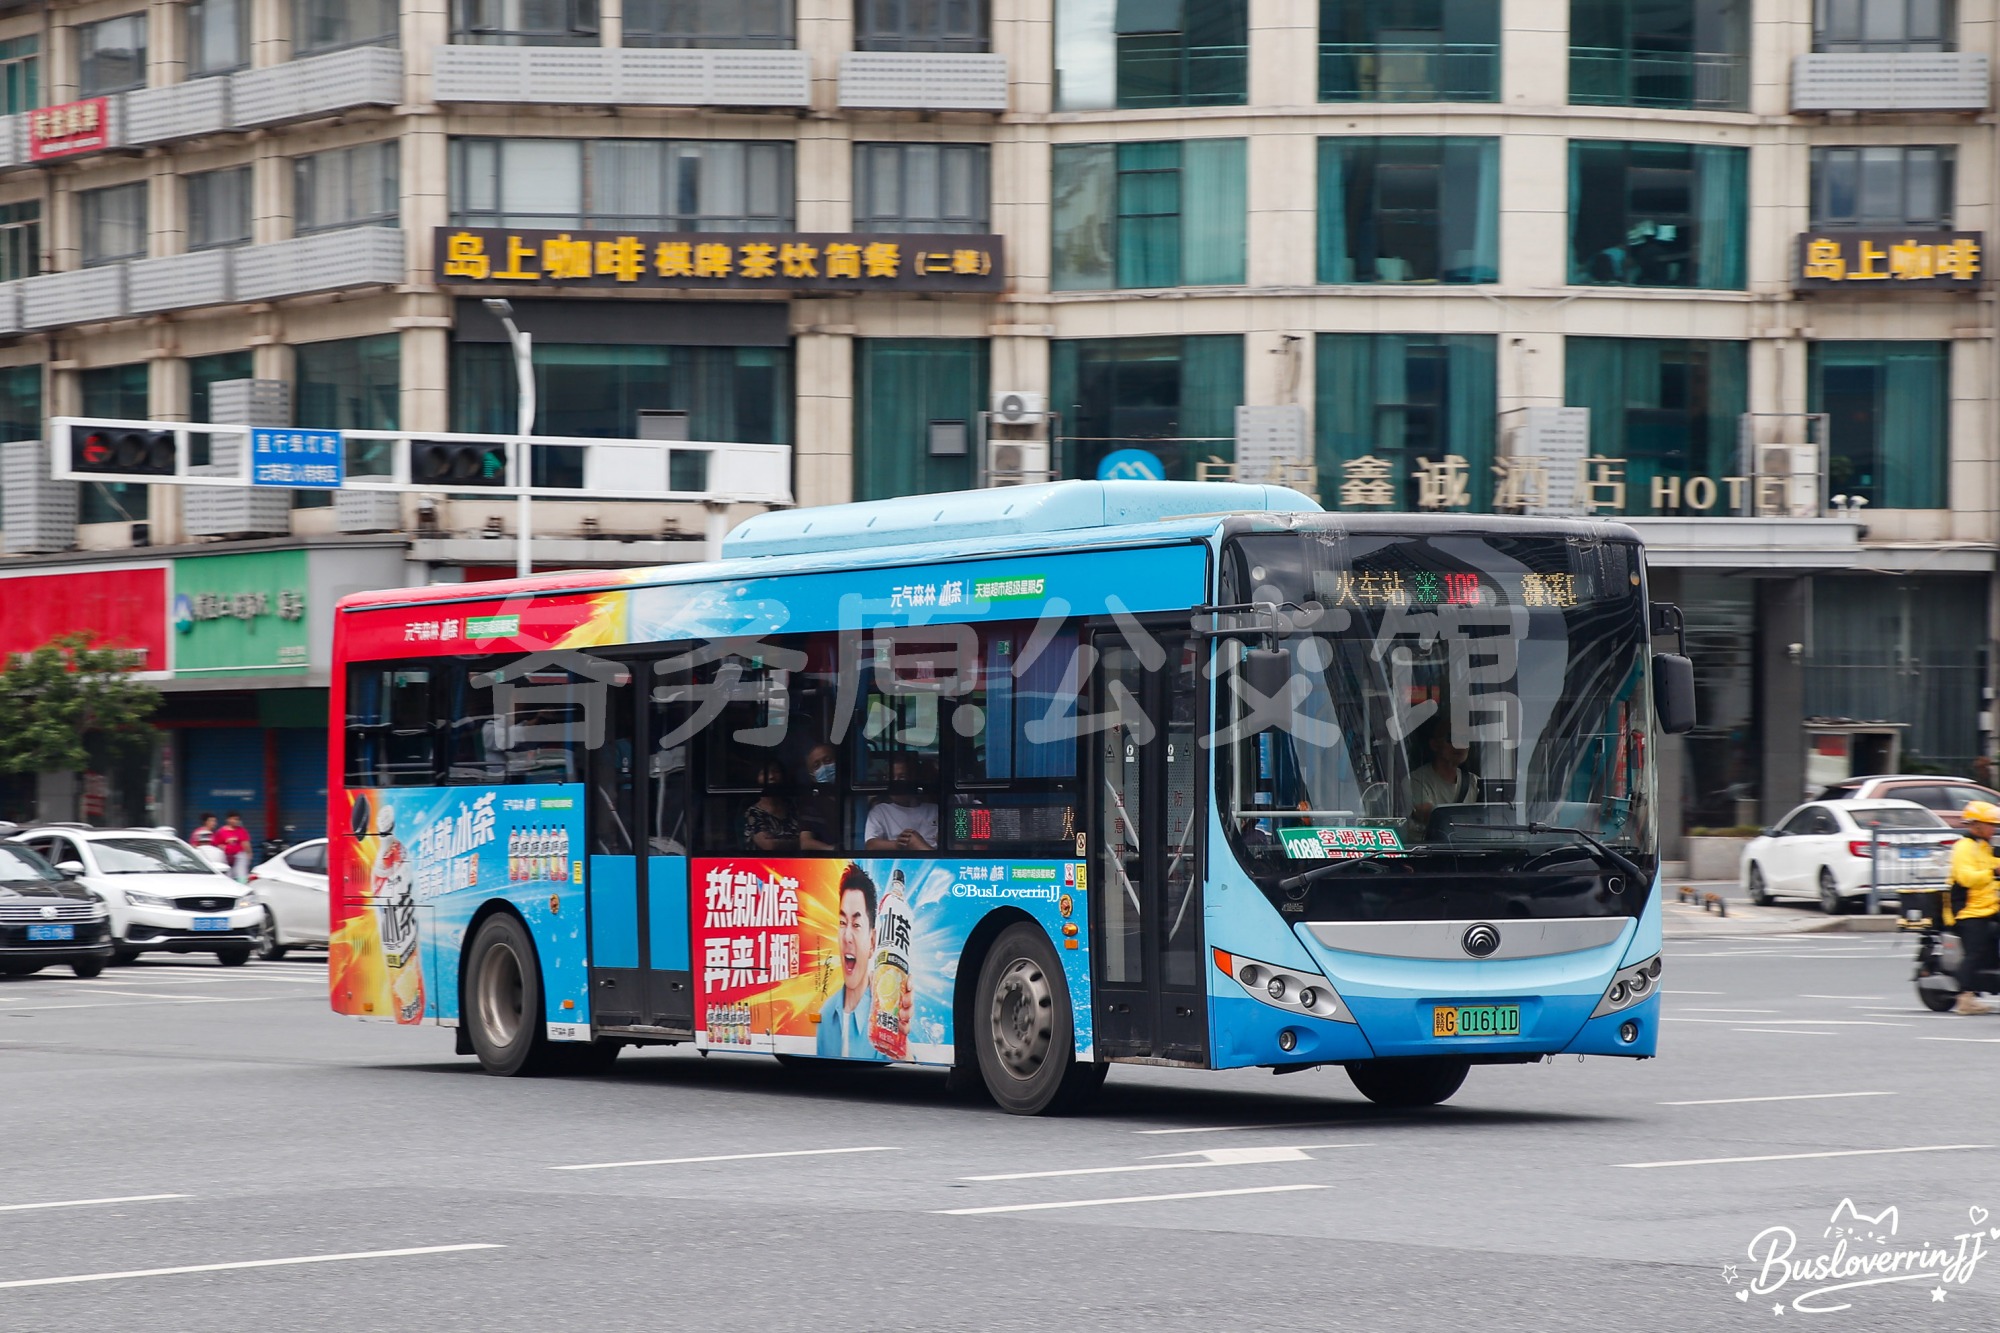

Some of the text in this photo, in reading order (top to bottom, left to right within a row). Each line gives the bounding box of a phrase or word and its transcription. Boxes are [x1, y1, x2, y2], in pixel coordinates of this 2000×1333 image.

[444, 232, 646, 281] 岛上咖啡
[654, 242, 732, 277] 棋牌
[739, 242, 818, 277] 茶饮
[824, 242, 900, 278] 简餐
[1803, 238, 1981, 281] 岛上咖啡
[891, 579, 1045, 608] 元气森林 冰茶 天猫超市超级星期5
[1336, 570, 1405, 606] 火车站
[1444, 573, 1480, 605] 108
[971, 809, 992, 839] 108
[1318, 830, 1398, 847] 空调开启
[1287, 837, 1325, 859] 108路
[958, 866, 989, 881] 元气森林
[703, 862, 799, 929] 热就冰茶
[704, 930, 791, 994] 再来1瓶
